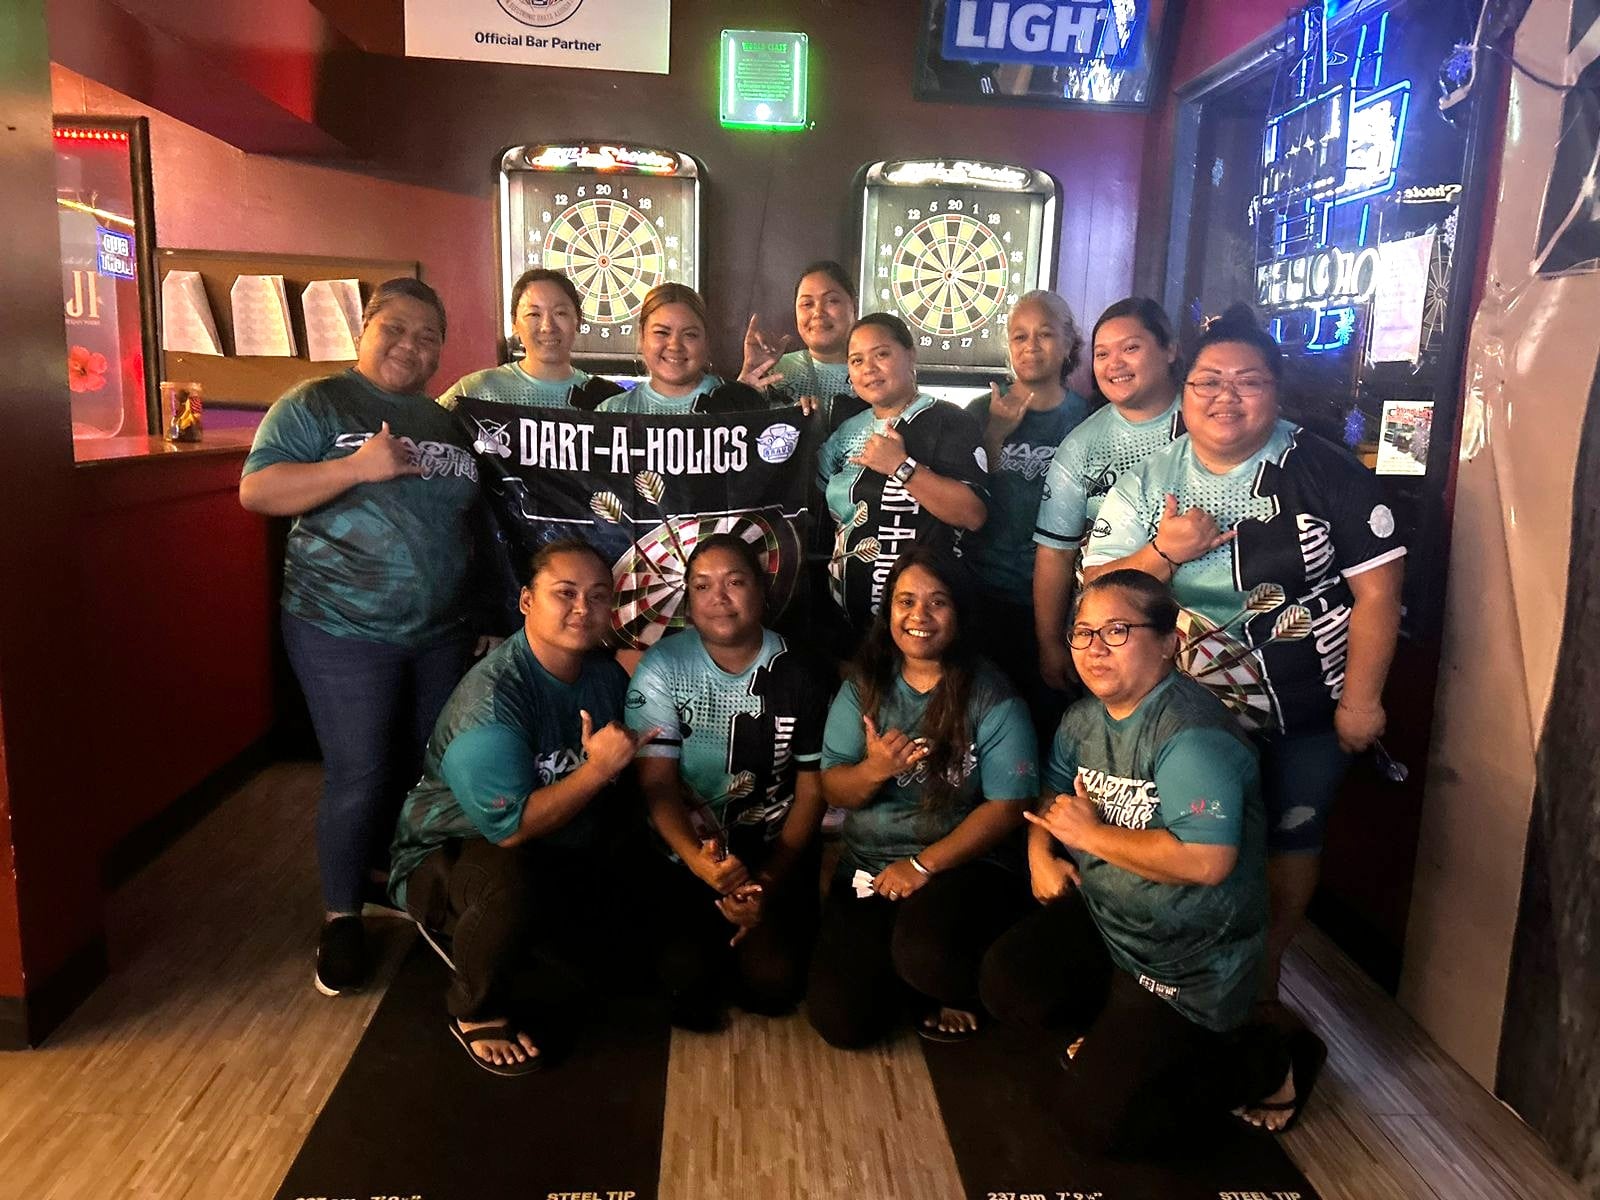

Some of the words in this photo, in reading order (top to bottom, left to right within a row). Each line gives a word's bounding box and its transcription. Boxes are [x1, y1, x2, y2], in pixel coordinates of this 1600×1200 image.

[474, 31, 522, 47] Official
[526, 35, 547, 49] Bar
[551, 37, 602, 52] Partner
[577, 187, 586, 197] 5
[595, 184, 612, 196] 20
[622, 188, 630, 199] 1
[554, 194, 569, 206] 12
[947, 199, 964, 211] 20
[929, 201, 938, 212] 5
[972, 204, 980, 215] 1
[907, 208, 921, 220] 12
[987, 213, 1001, 225] 18
[655, 216, 665, 228] 4
[894, 226, 904, 237] 9
[1003, 231, 1012, 243] 4
[619, 324, 633, 336] 17
[980, 329, 990, 340] 2
[919, 336, 933, 348] 19
[941, 339, 951, 351] 3
[960, 337, 973, 349] 17
[518, 417, 749, 476] DART-A-HOLICS
